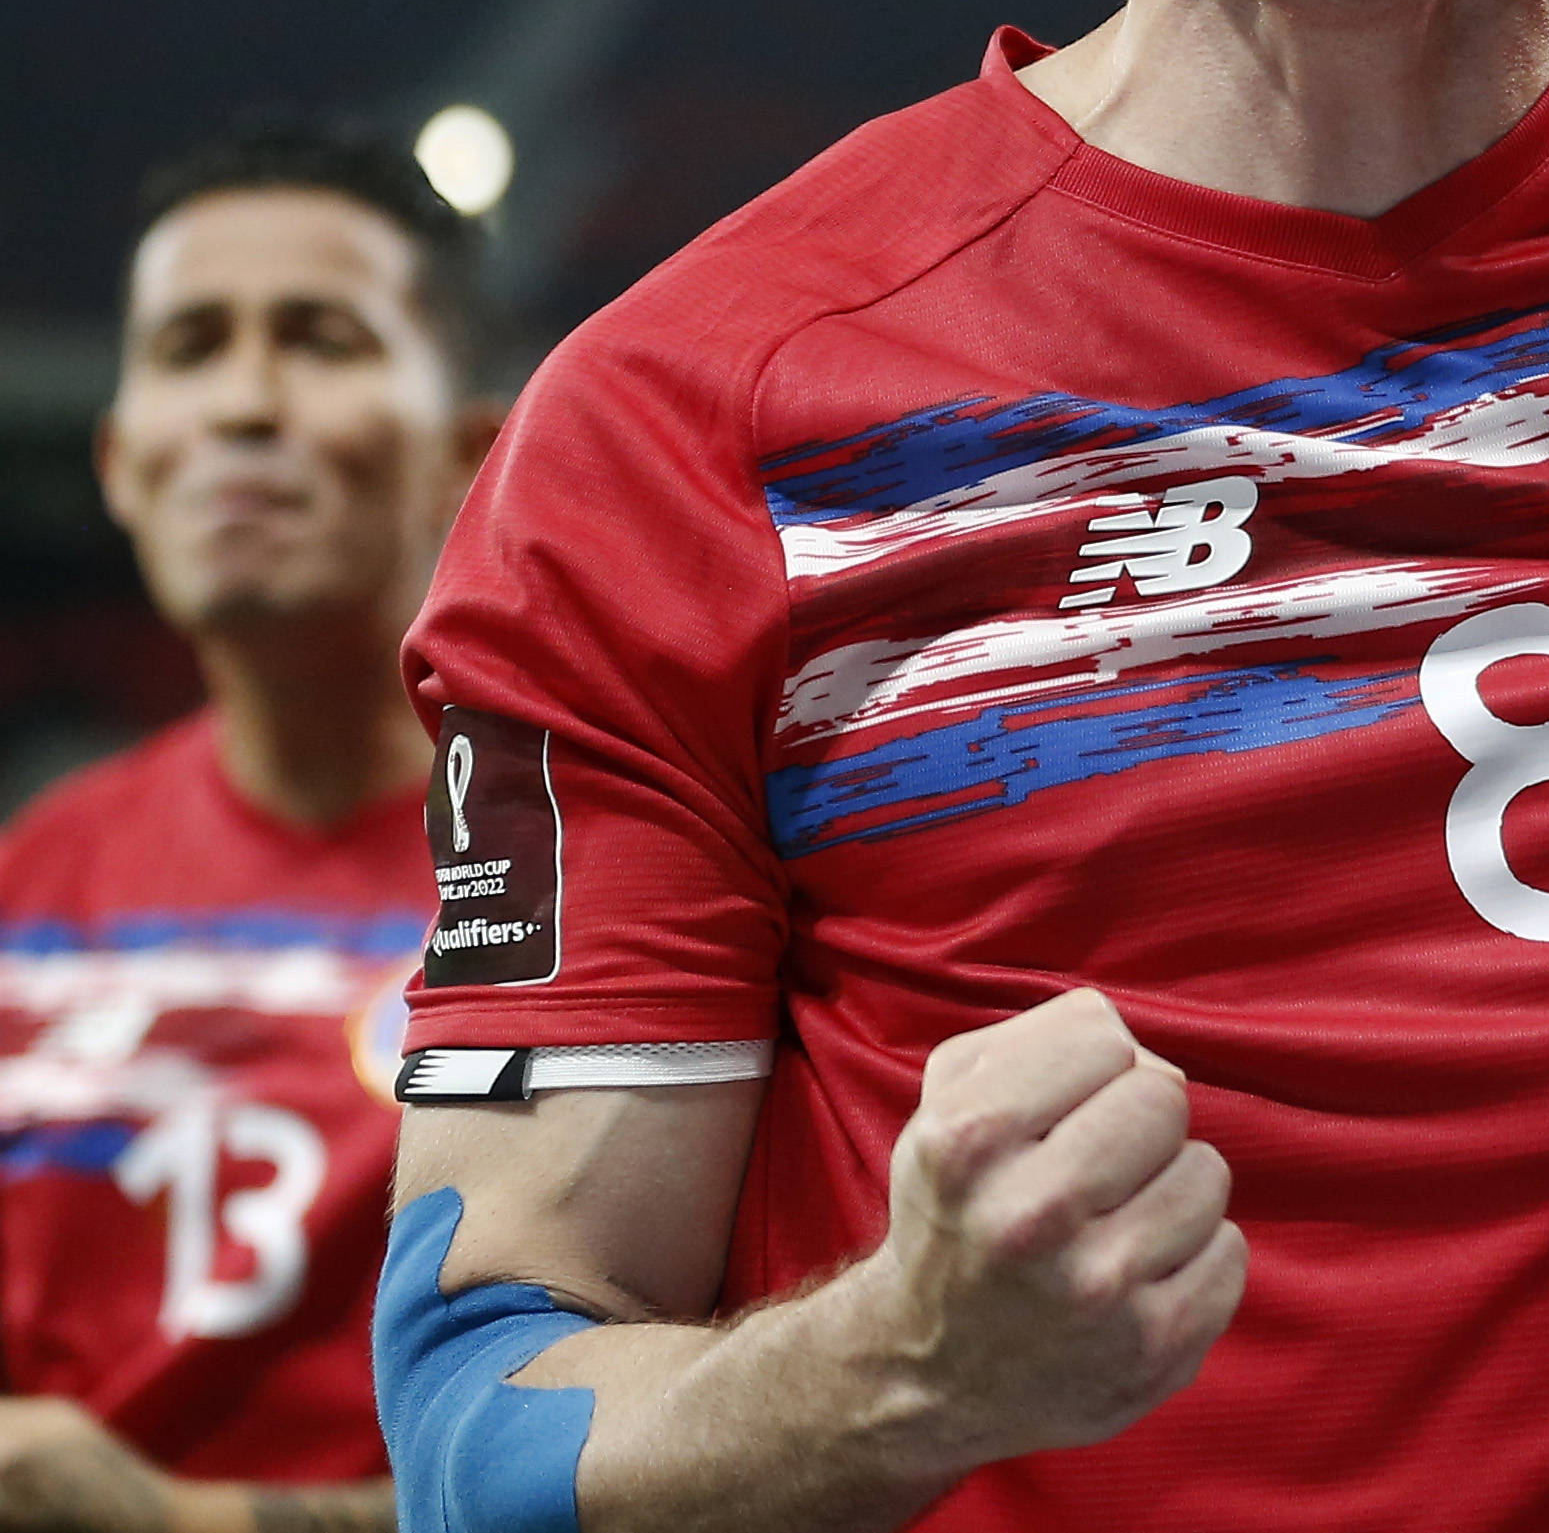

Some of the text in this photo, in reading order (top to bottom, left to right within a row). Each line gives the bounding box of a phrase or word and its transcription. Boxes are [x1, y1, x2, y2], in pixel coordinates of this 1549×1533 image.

[1058, 475, 1259, 609] NB
[484, 859, 511, 876] CUP
[109, 1096, 328, 1344] 13
